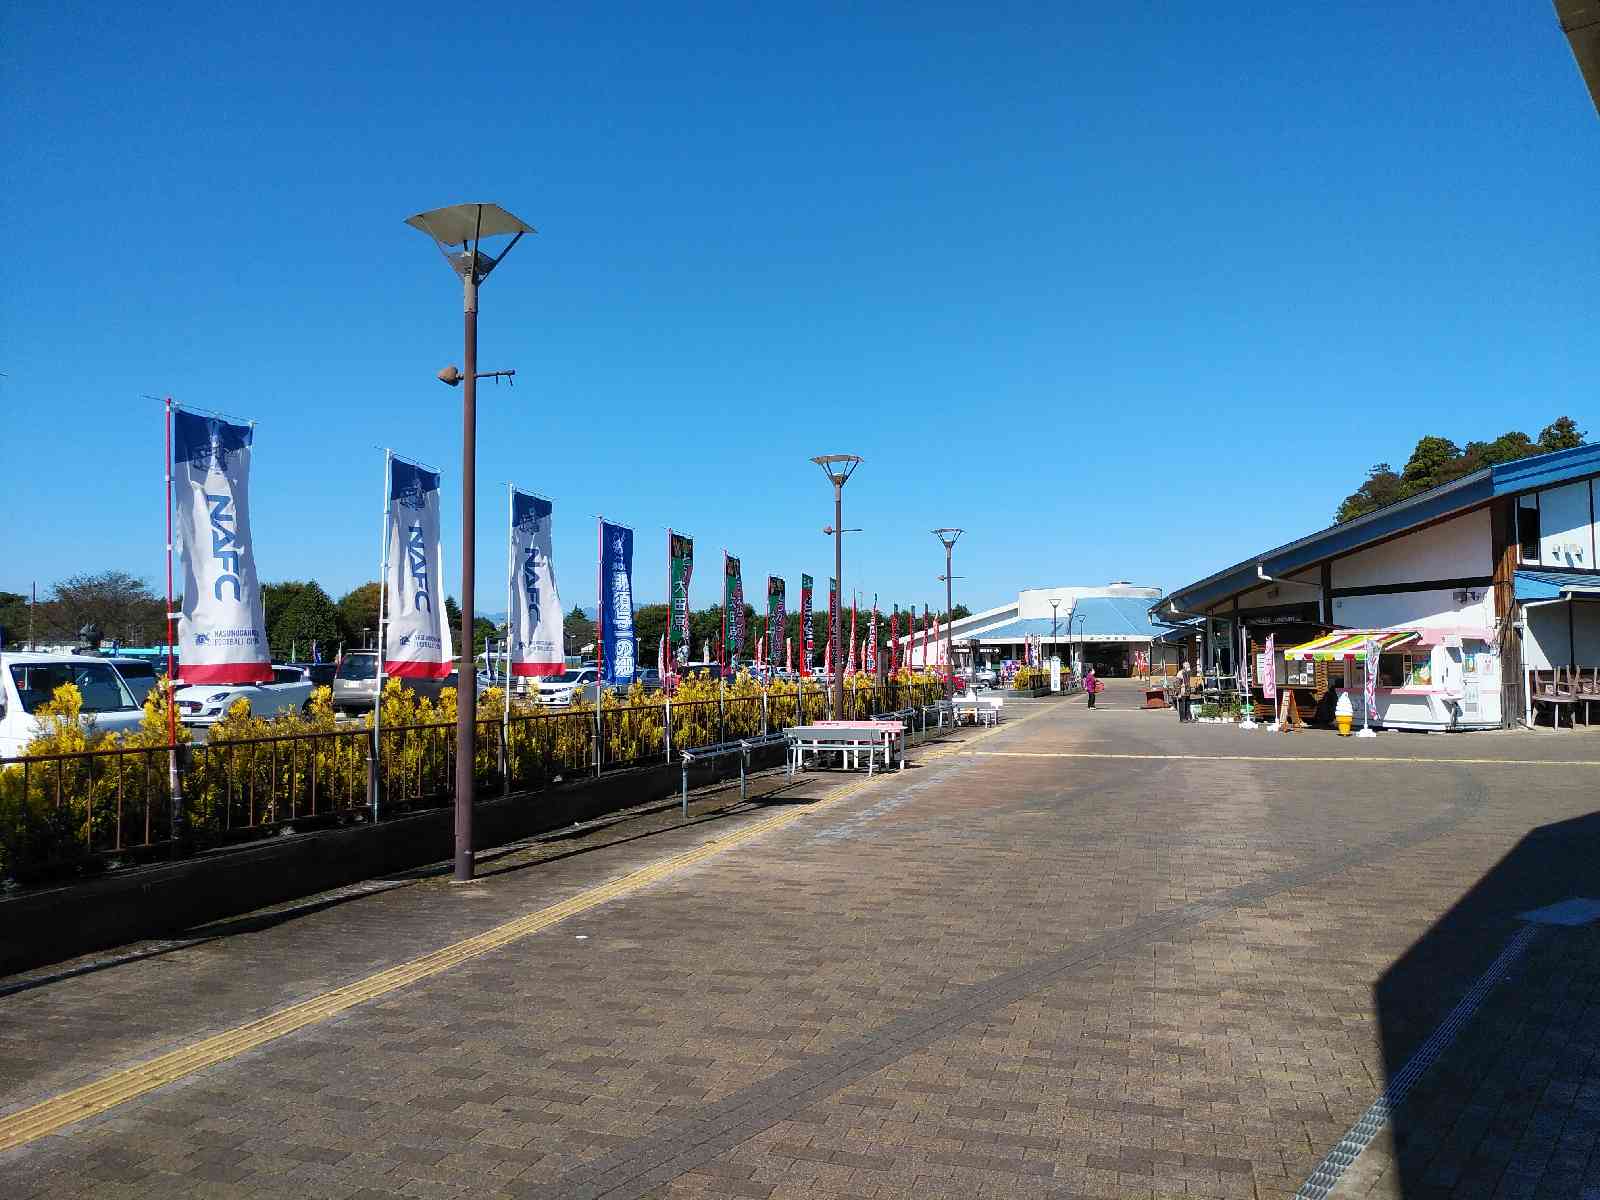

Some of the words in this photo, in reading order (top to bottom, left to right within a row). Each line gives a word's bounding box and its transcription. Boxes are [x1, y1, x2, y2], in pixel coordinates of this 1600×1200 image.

[207, 494, 243, 603] NAFC
[408, 526, 432, 613] NAFC
[524, 547, 541, 622] NAFC
[673, 580, 687, 632] 大田原
